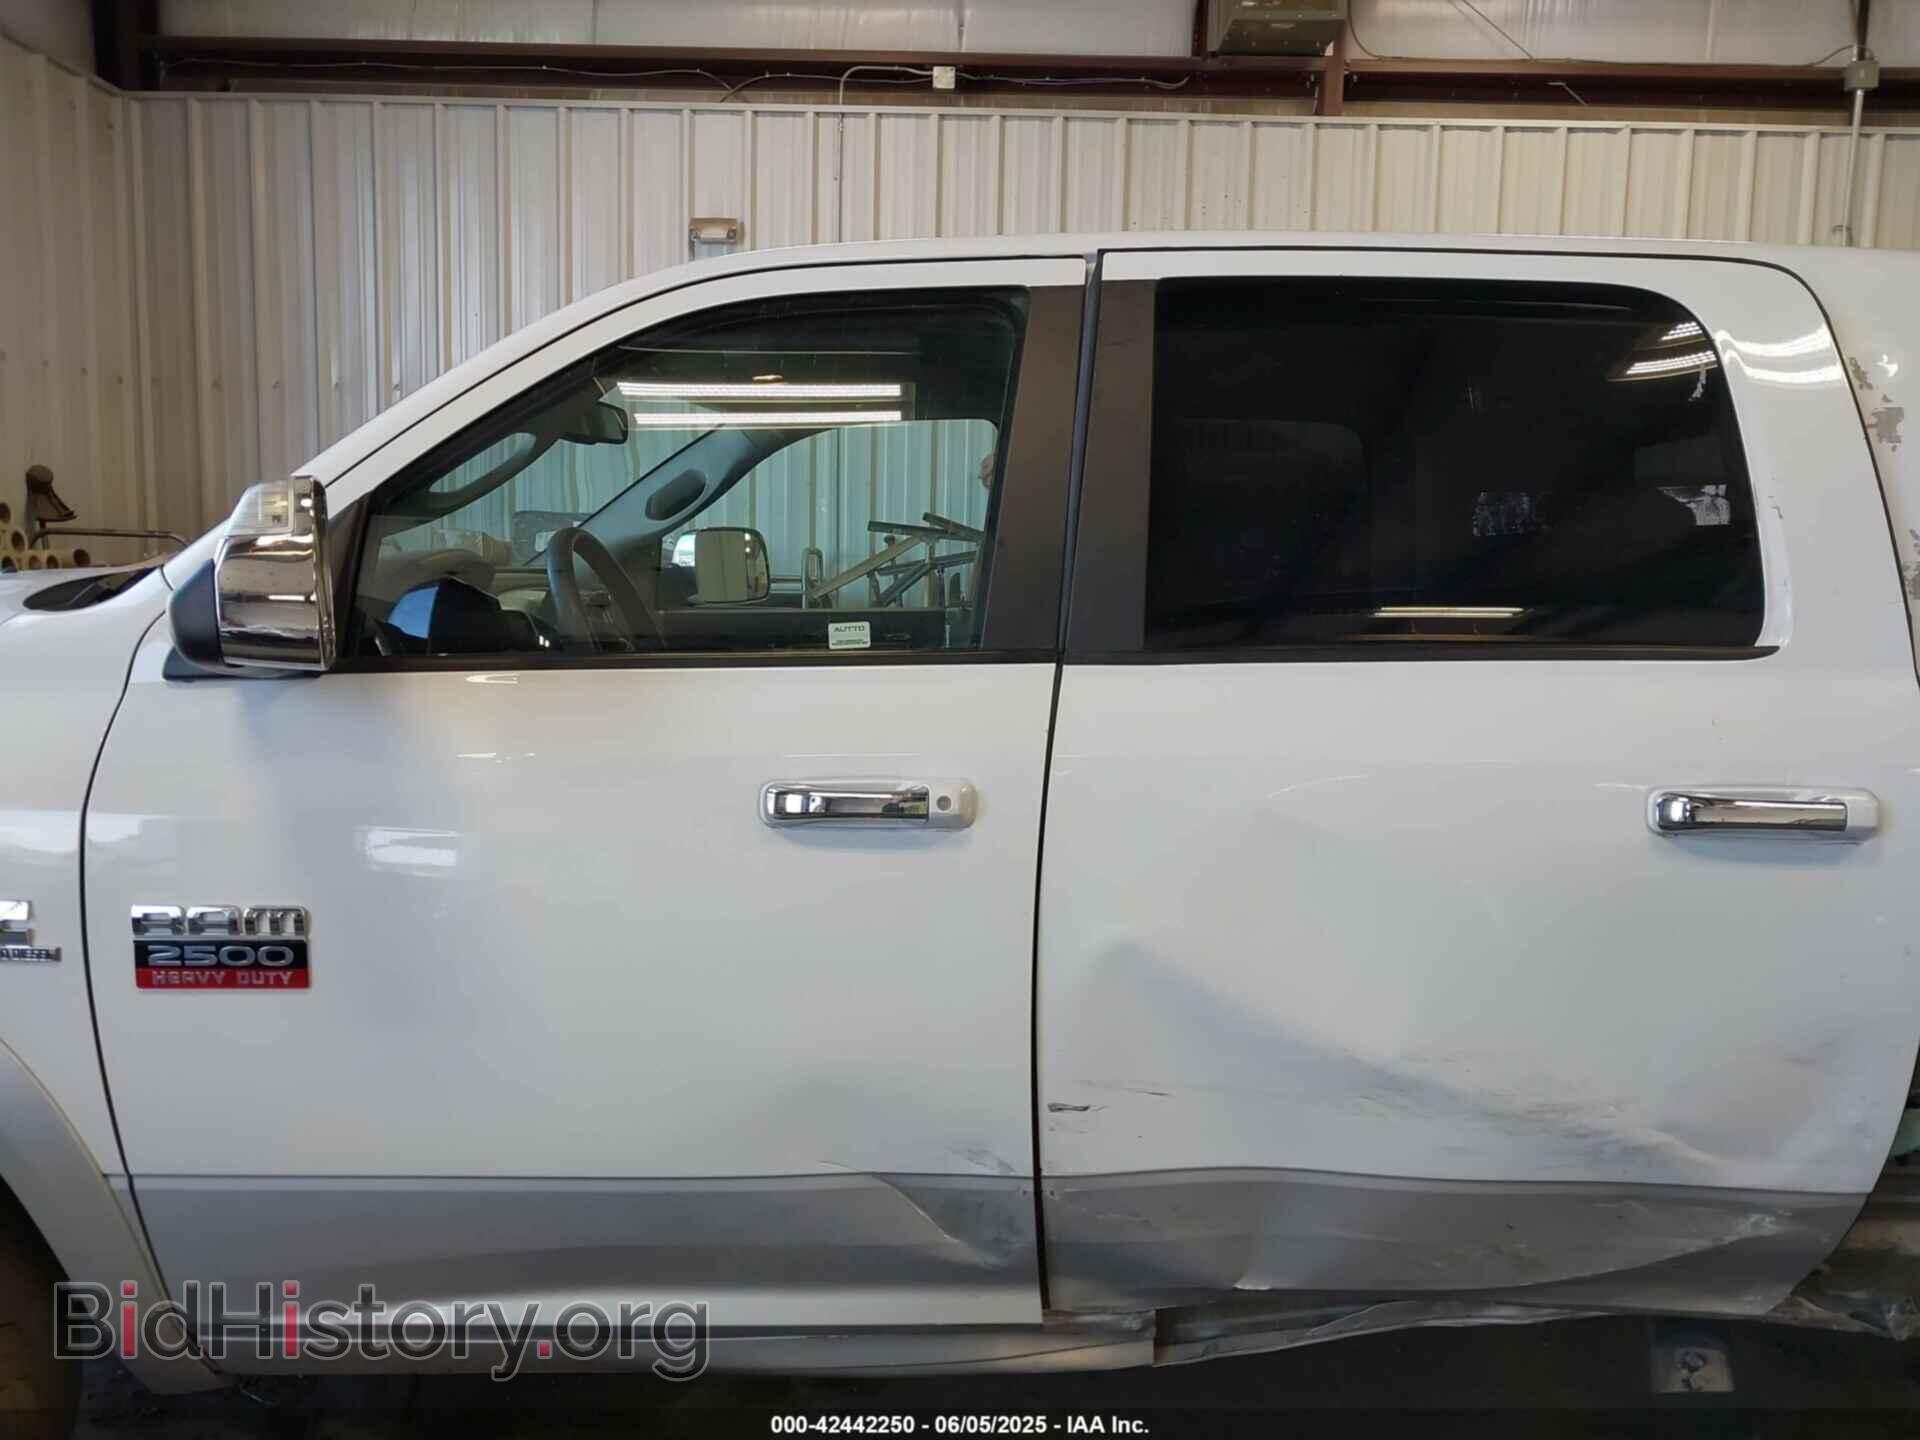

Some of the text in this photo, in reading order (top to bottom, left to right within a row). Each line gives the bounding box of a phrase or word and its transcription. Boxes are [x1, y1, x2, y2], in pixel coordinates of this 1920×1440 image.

[147, 945, 294, 966] 2500
[153, 971, 294, 985] HEAVY DUTY
